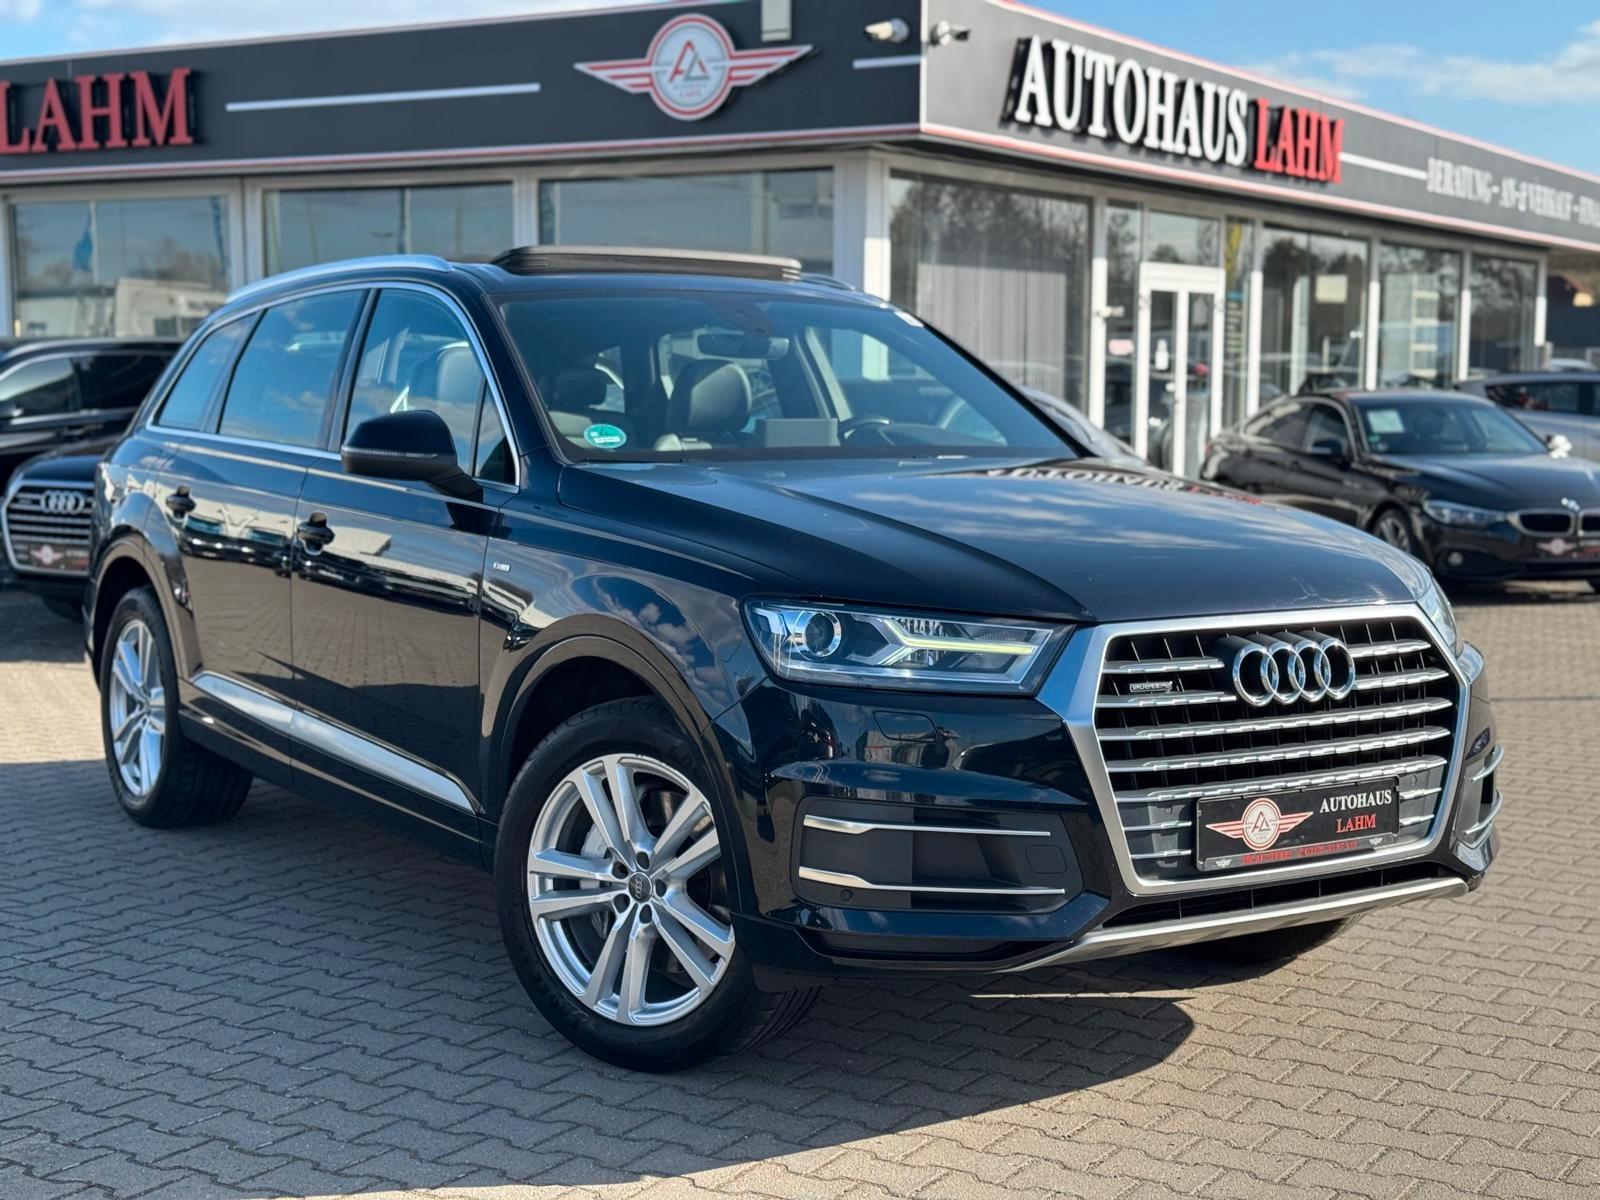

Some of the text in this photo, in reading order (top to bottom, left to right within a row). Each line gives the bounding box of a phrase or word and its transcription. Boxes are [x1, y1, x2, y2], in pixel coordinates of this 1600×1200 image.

[0, 67, 193, 154] LAHM
[1014, 35, 1345, 184] AUTOHAUS LAHM
[1319, 789, 1392, 814] AUTOHAUS
[1335, 813, 1377, 833] LAHM
